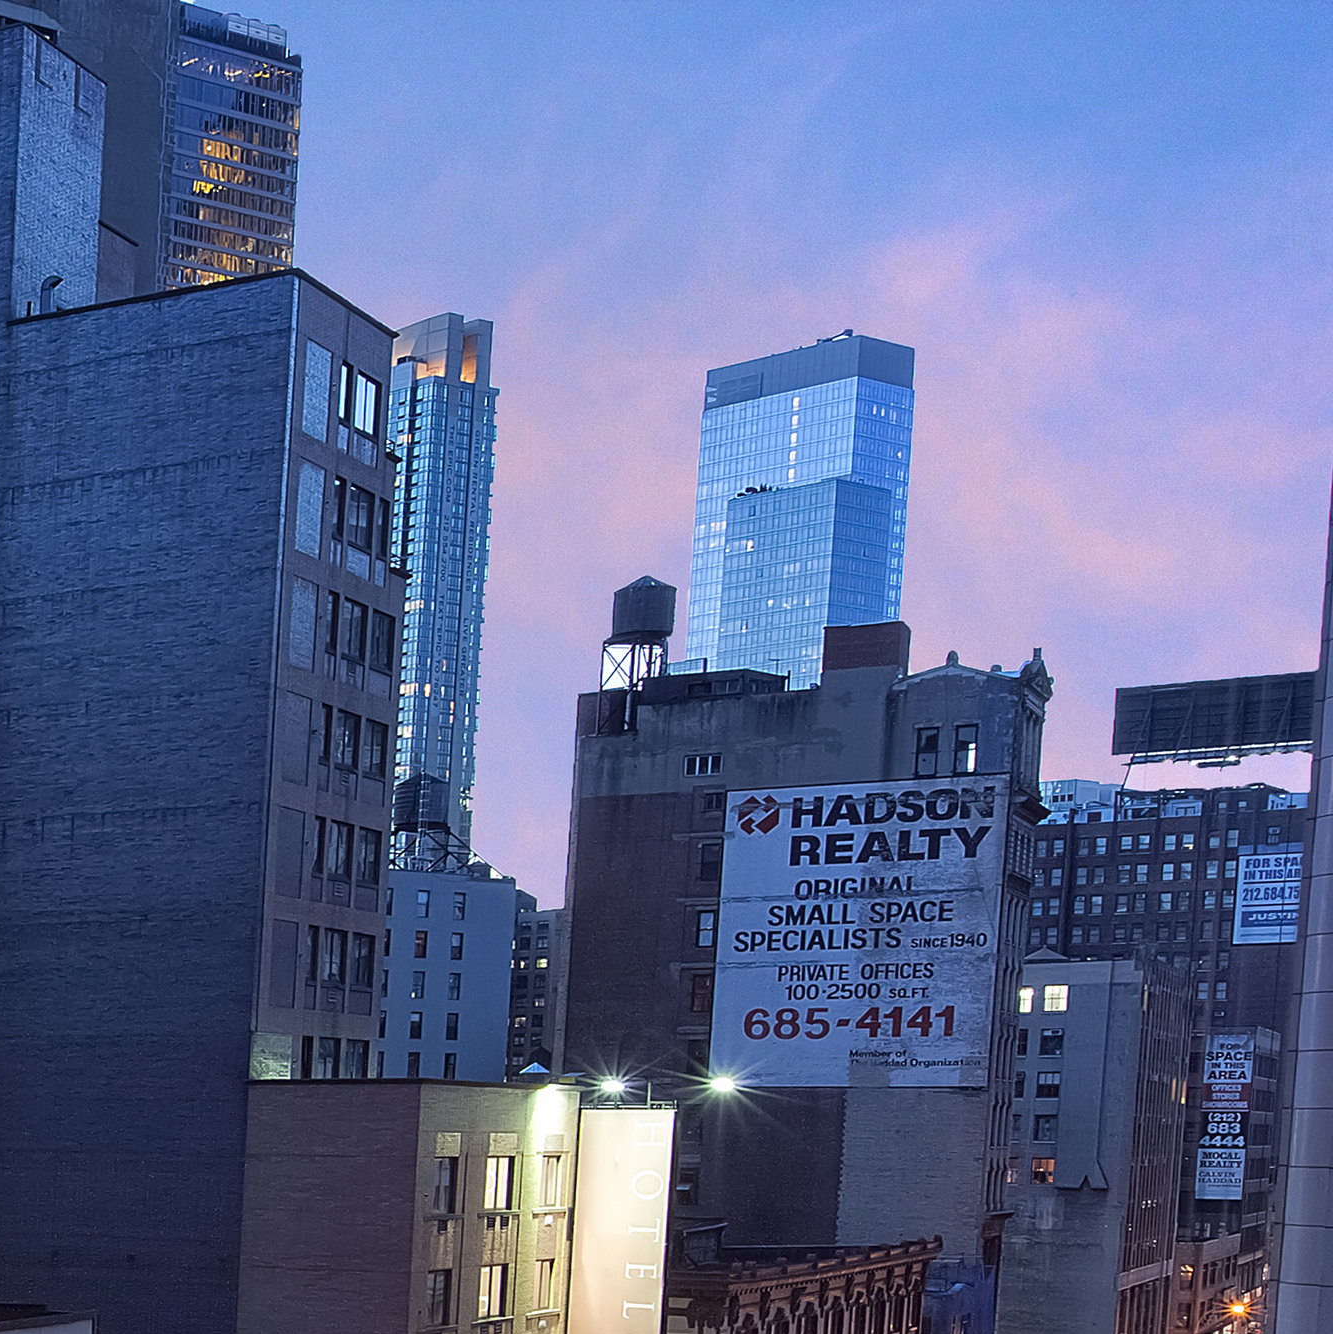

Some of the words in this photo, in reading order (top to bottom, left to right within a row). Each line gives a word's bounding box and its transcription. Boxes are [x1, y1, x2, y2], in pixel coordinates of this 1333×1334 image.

[472, 430, 481, 468] GREEN
[445, 450, 454, 503] EPIC.COM
[469, 472, 479, 516] RENTAL
[465, 520, 476, 592] RESIDENCES
[459, 646, 468, 697] GREATER
[790, 786, 996, 829] HADSON
[789, 825, 992, 867] REALTY
[1243, 870, 1256, 881] IN
[1257, 869, 1283, 880] THIS
[1286, 868, 1301, 879] AR
[1245, 858, 1270, 869] FOR
[1273, 857, 1300, 868] SPA
[794, 876, 913, 901] ORIGINAL
[1242, 886, 1300, 901] 212.684.75
[767, 903, 856, 927] SMALL
[868, 900, 954, 924] SPACE
[733, 927, 903, 952] SPECIALISTS
[910, 937, 948, 949] SINCE
[948, 933, 988, 948] 1940
[777, 964, 850, 982] PRIVATE
[860, 962, 934, 980] OFFICES
[743, 1005, 955, 1040] 685-4141
[849, 1050, 893, 1059] Member
[895, 1049, 907, 1058] of
[1206, 1051, 1252, 1062] SPACE
[1207, 1070, 1247, 1080] AREA
[1206, 1123, 1241, 1134] 683
[1208, 1113, 1241, 1122] (212)
[1199, 1135, 1245, 1147] 4444
[1199, 1160, 1243, 1168] REALTY
[622, 1121, 668, 1320] HOTEL
